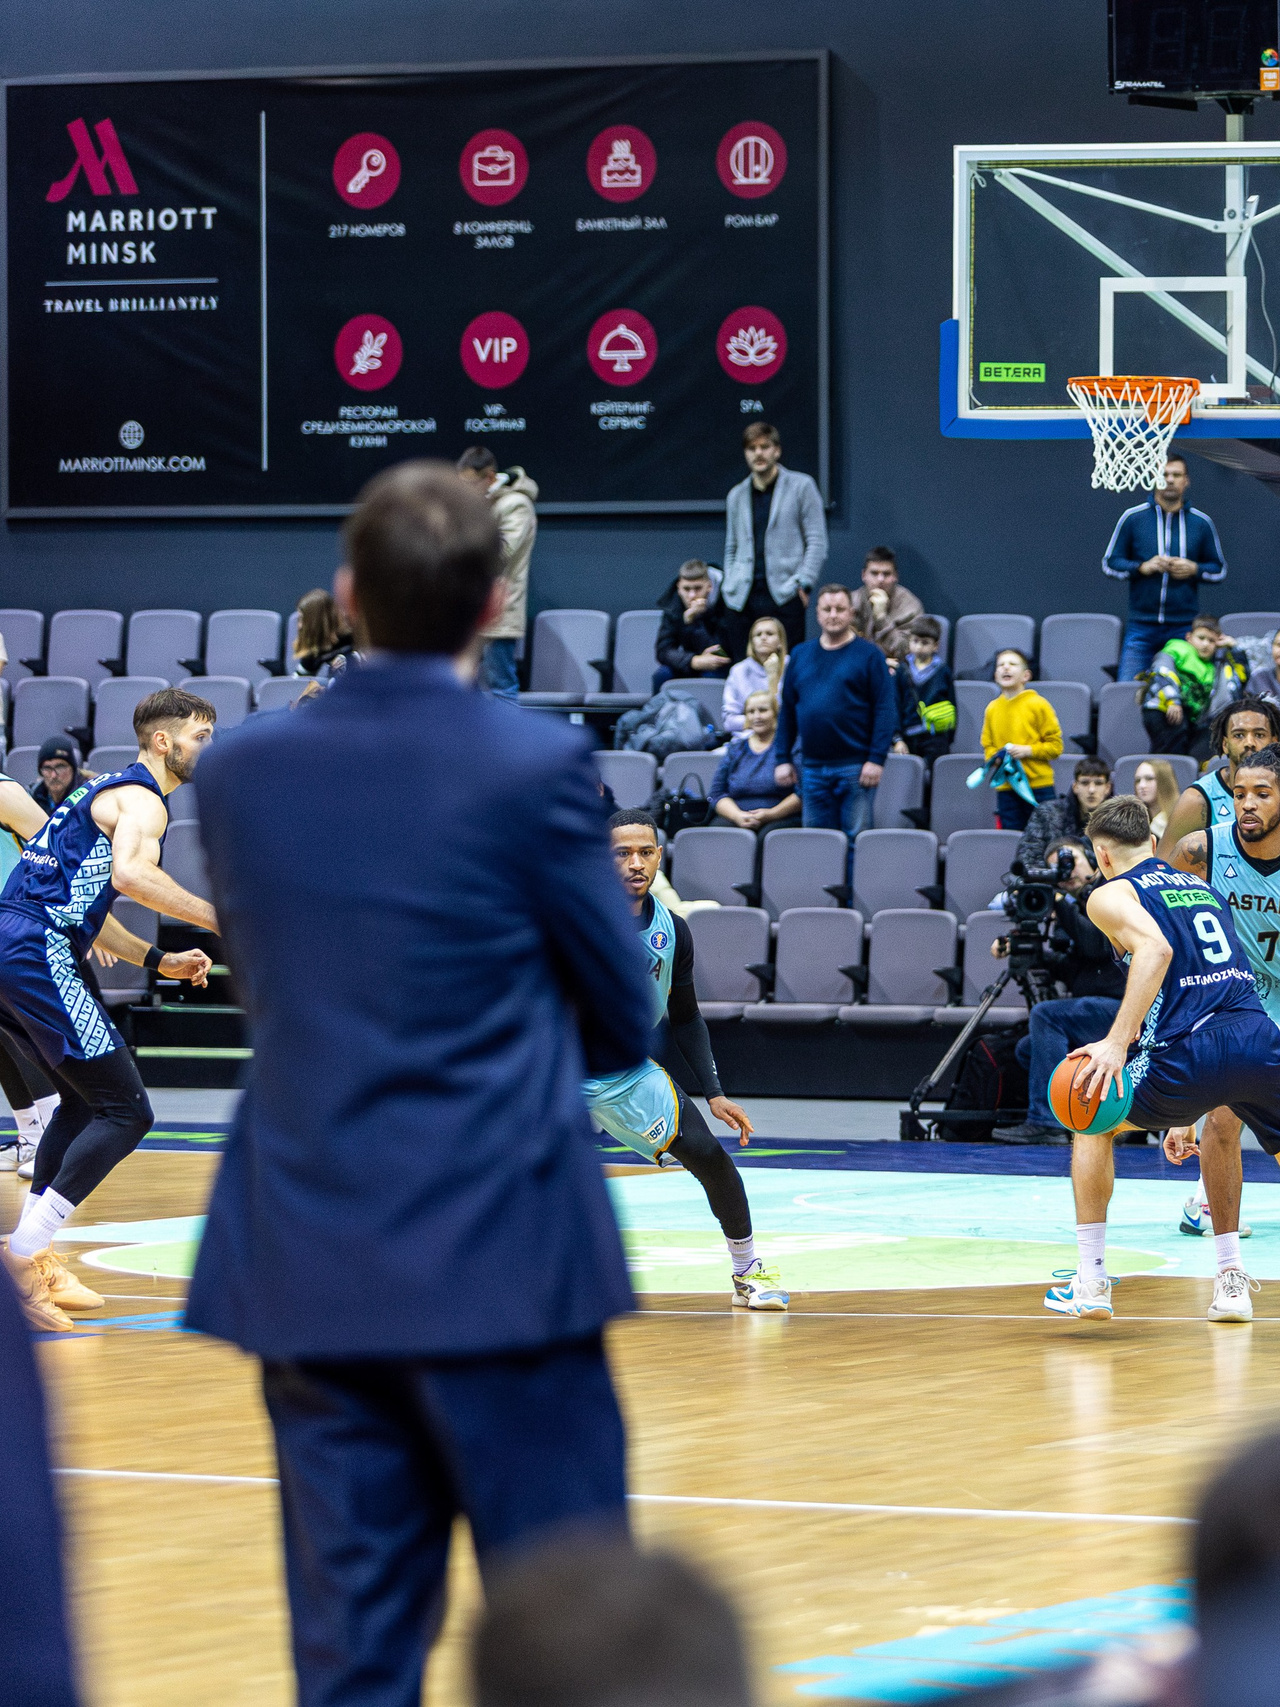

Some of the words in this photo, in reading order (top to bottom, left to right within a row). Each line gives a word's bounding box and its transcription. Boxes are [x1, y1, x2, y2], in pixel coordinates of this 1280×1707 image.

[66, 207, 218, 233] MARRIOTT
[575, 215, 642, 232] БАНКЕТНЫЙ
[643, 216, 668, 230] ЗАЛ
[328, 224, 349, 239] 217
[350, 222, 406, 238] НОМЕРОВ
[473, 235, 515, 249] ЗАЛОВ
[66, 241, 157, 265] MINSK
[43, 298, 104, 313] TRAVEL
[108, 296, 218, 312] BRILLIANTLY
[472, 336, 518, 363] VIP
[338, 405, 398, 420] РЕСТОРАН
[740, 399, 764, 413] SPA
[301, 418, 437, 435] СРЕДИЗЕМНОМОРСКОЙ
[464, 417, 526, 432] ГОСТИНАЯ
[598, 415, 647, 430] СЕРВИС
[348, 435, 388, 449] КУХНИ
[58, 455, 207, 473] MARRIOTTMINSK.COM
[1192, 911, 1232, 964] 9
[1257, 931, 1279, 962] 7
